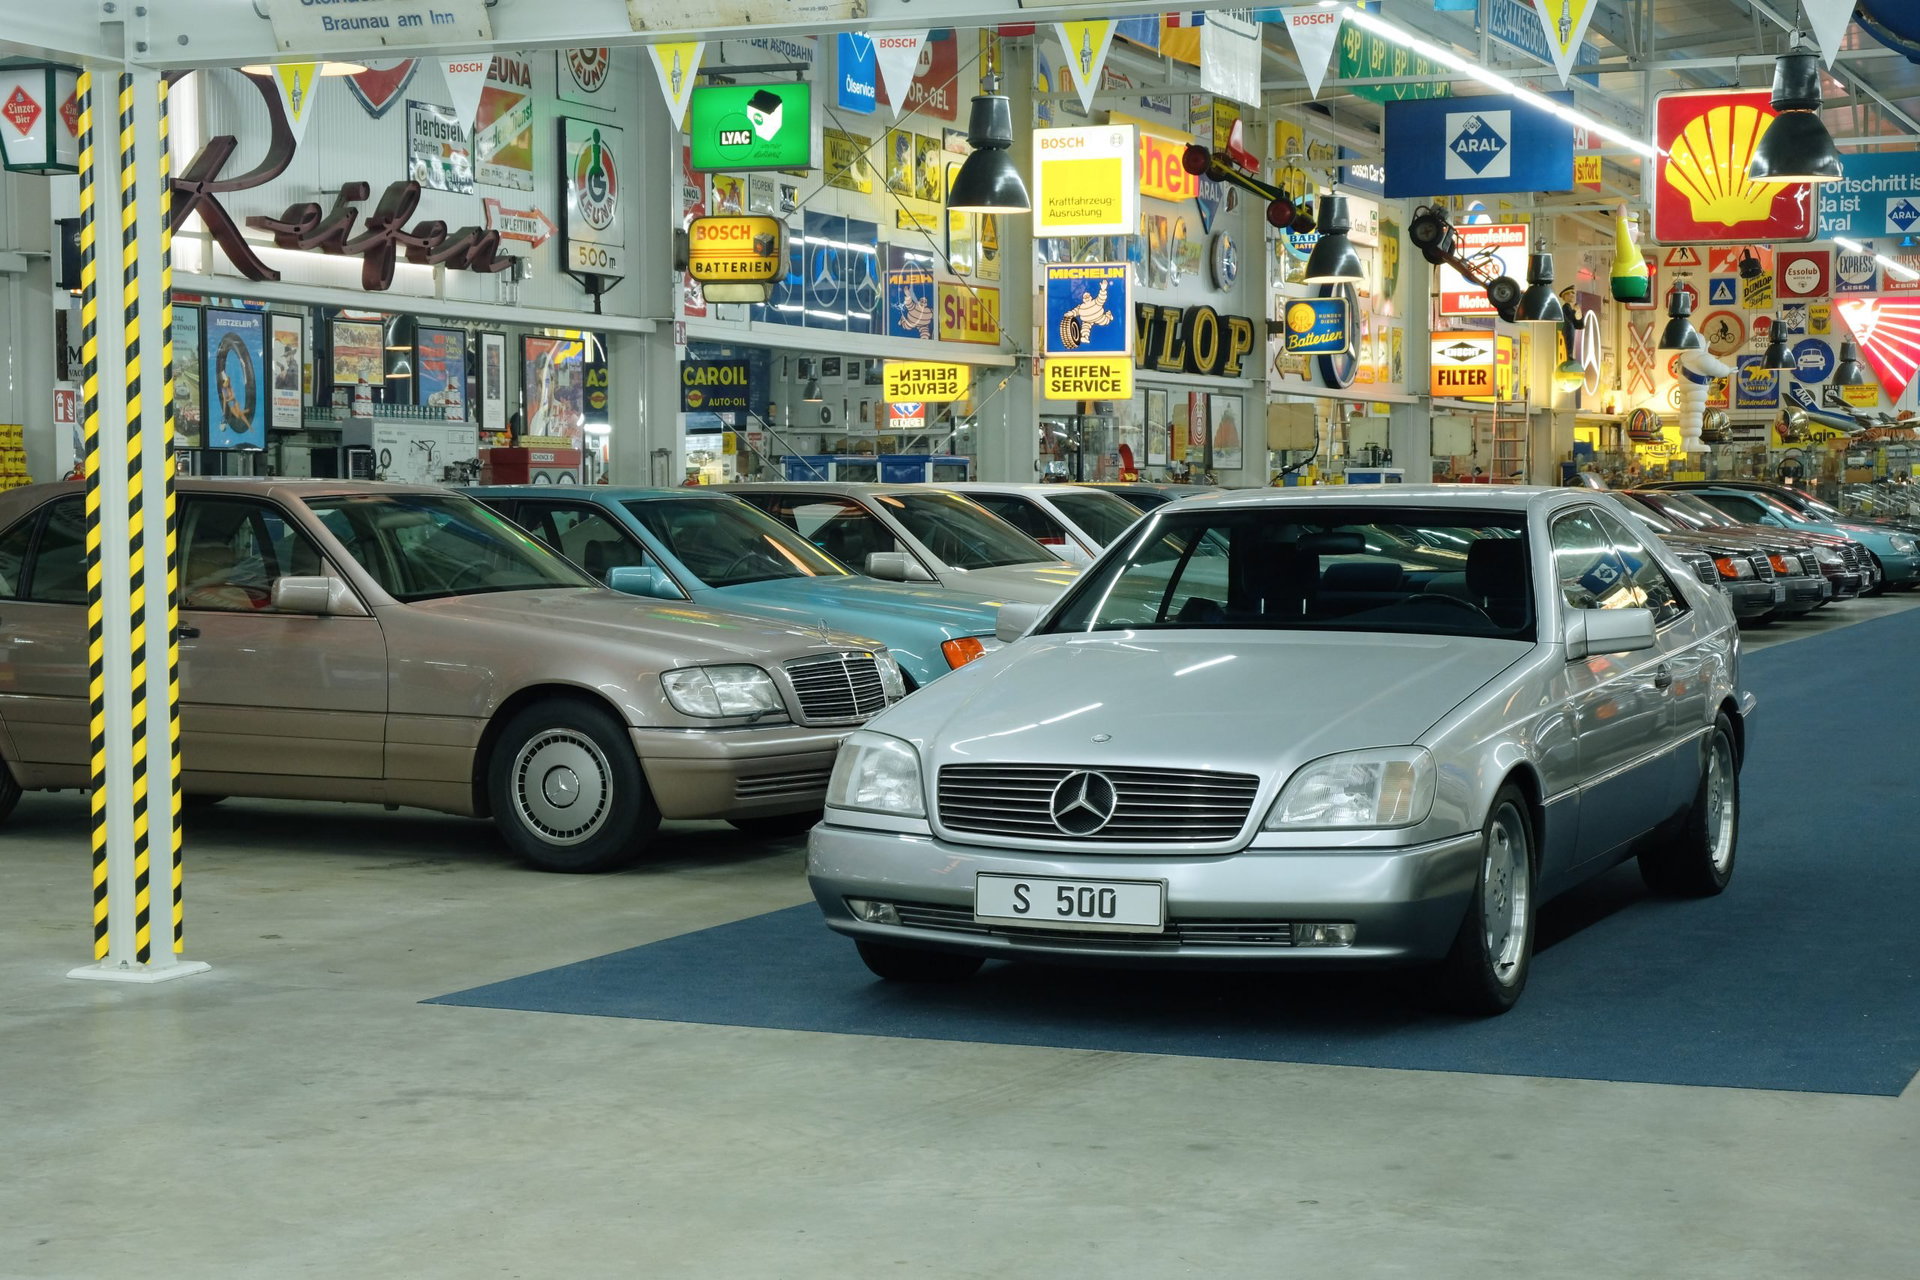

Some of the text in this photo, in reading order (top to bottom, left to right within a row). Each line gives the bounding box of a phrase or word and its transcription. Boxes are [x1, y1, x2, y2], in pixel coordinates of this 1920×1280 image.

[321, 9, 455, 31] Braunau am Inn
[1293, 13, 1334, 26] BOSCH
[770, 38, 813, 62] AUTOBAHN
[880, 38, 917, 48] BOSCH
[1371, 37, 1385, 71] BP
[449, 62, 483, 74] BOSCH
[571, 48, 607, 86] LEUNA
[845, 74, 875, 98] Ölservice
[908, 81, 949, 111] OR-OEL
[8, 103, 35, 114] Linzer
[15, 114, 30, 124] Bier
[721, 130, 750, 145] LYAC
[1041, 137, 1084, 149] BOSCH
[1456, 137, 1500, 152] ARAL
[1369, 164, 1380, 181] Car
[1199, 180, 1219, 202] ARAL
[580, 193, 615, 224] LEUNA
[1049, 197, 1115, 207] Kraftfahrzeug-
[1840, 195, 1861, 212] ist
[1049, 208, 1102, 218] Ausrüstung
[1891, 211, 1918, 220] ARAL
[1819, 214, 1851, 231] Aral
[696, 225, 751, 241] BOSCH
[1464, 228, 1523, 246] empfehlen
[579, 246, 607, 266] 500
[1840, 255, 1873, 273] EXPRESS
[696, 262, 772, 273] BATTERIEN
[1049, 267, 1124, 279] MICHELIN
[1787, 268, 1818, 276] Essolub
[1744, 276, 1772, 297] DUNLOP
[944, 294, 996, 333] SHELL
[216, 318, 252, 328] METZELER
[1287, 329, 1344, 350] Batterien
[683, 366, 748, 386] CAROIL
[1051, 365, 1121, 378] REIFEN-
[1438, 369, 1487, 386] FILTER
[1051, 379, 1121, 392] SERVICE
[708, 397, 747, 407] AUTO-OIL
[1793, 388, 1812, 406] ANA
[1013, 883, 1117, 919] S 500
